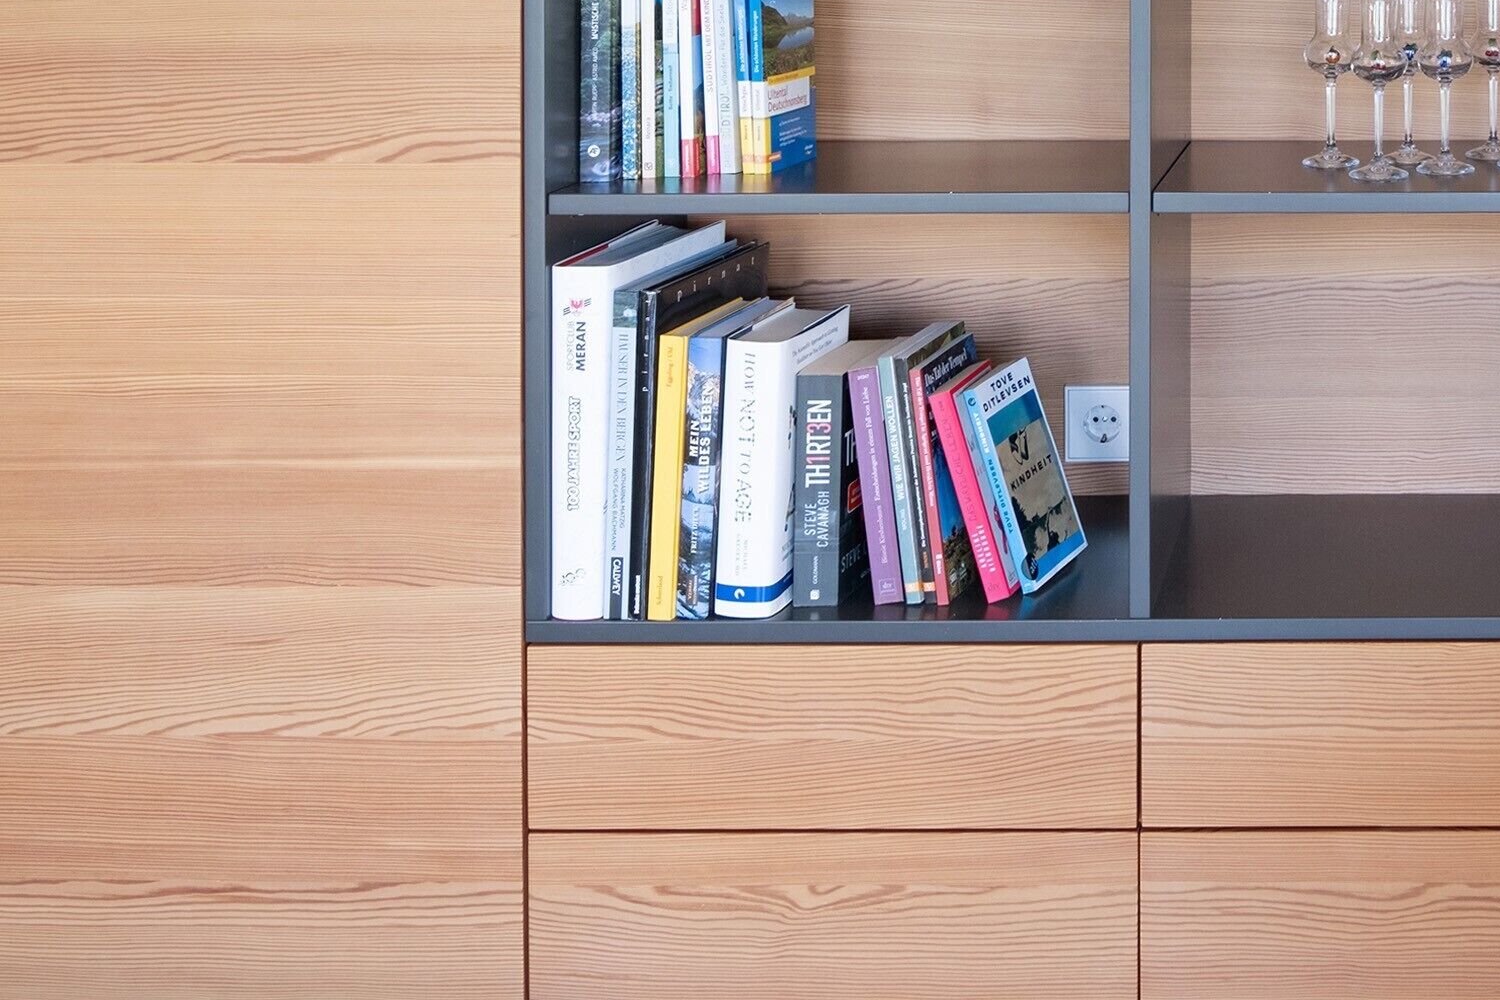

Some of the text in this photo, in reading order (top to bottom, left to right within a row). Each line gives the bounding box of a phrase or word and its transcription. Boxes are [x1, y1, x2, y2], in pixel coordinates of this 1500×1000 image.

[703, 16, 711, 32] DEM
[566, 321, 575, 372] SPORTCLUB
[575, 321, 586, 372] MERAN
[617, 377, 627, 388] IN
[924, 372, 936, 386] Das
[948, 347, 968, 370] Tempel
[990, 371, 1014, 392] TOVE
[616, 391, 627, 414] DEN
[886, 395, 897, 427] WOLLEN
[983, 375, 1031, 412] DITLEVSEN
[566, 396, 580, 511] 100 JAHRE SPORT
[615, 417, 626, 462] BERGEN
[689, 420, 700, 457] MEIN
[697, 385, 714, 493] WILDES LEBEN
[734, 353, 756, 522] HOW NOT TO AGE
[805, 400, 832, 488] TH1RT3EN
[890, 428, 899, 461] JAGEN
[870, 455, 881, 502] Entscheidungen
[894, 462, 902, 480] WIR
[973, 413, 1014, 534] TOVE DITLEVSEN KINDHEIT
[1010, 454, 1052, 491] KINDHEIT
[896, 481, 905, 502] WIE
[803, 503, 816, 536] STEVE
[816, 491, 830, 547] CAVANAGH
[690, 532, 698, 553] FRITZ
[841, 543, 861, 574] STEVE
